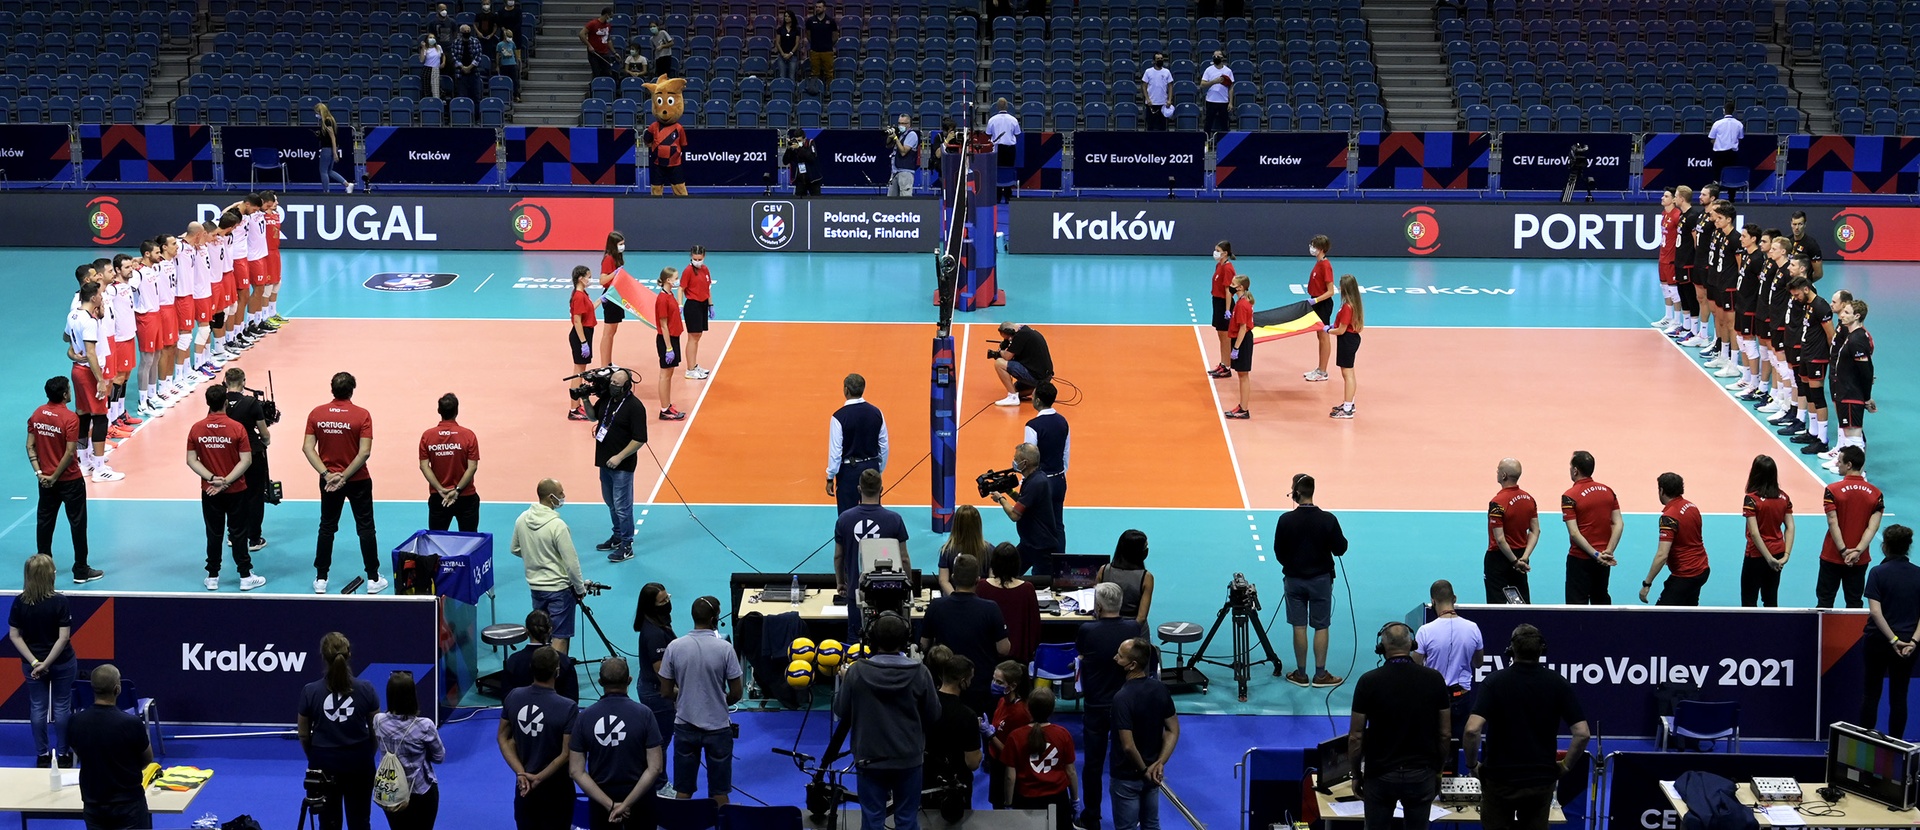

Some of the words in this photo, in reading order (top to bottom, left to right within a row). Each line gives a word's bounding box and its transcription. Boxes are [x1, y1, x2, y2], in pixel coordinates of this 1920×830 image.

[409, 150, 450, 161] Kraków
[685, 152, 740, 164] EuroVolley
[744, 152, 767, 162] 2021
[835, 152, 877, 163] Kraków
[1085, 153, 1107, 163] CEV
[1110, 153, 1167, 165] EuroVolley
[1169, 154, 1193, 164] 2021
[1259, 155, 1302, 165] Kraków
[1512, 156, 1535, 165] CEV
[1595, 157, 1620, 166] 2021
[1687, 157, 1712, 167] Krak
[763, 204, 783, 213] CEV
[824, 211, 870, 225] Poland,
[872, 211, 921, 223] Czechia
[1052, 210, 1176, 241] Kraków
[824, 227, 872, 240] Estonia,
[874, 226, 920, 239] Finland
[1357, 285, 1516, 295] Kraków
[33, 422, 62, 434] PORTUGAL
[317, 421, 351, 430] PORTUGAL
[198, 435, 232, 444] PORTUGAL
[428, 443, 462, 451] PORTUGAL
[1581, 485, 1608, 498] BELGIUM
[1841, 484, 1873, 495] BELGIUM
[1508, 494, 1531, 506] BELGIUM
[182, 642, 307, 671] Kraków
[1718, 657, 1794, 687] 2021
[1640, 809, 1677, 830] CE
